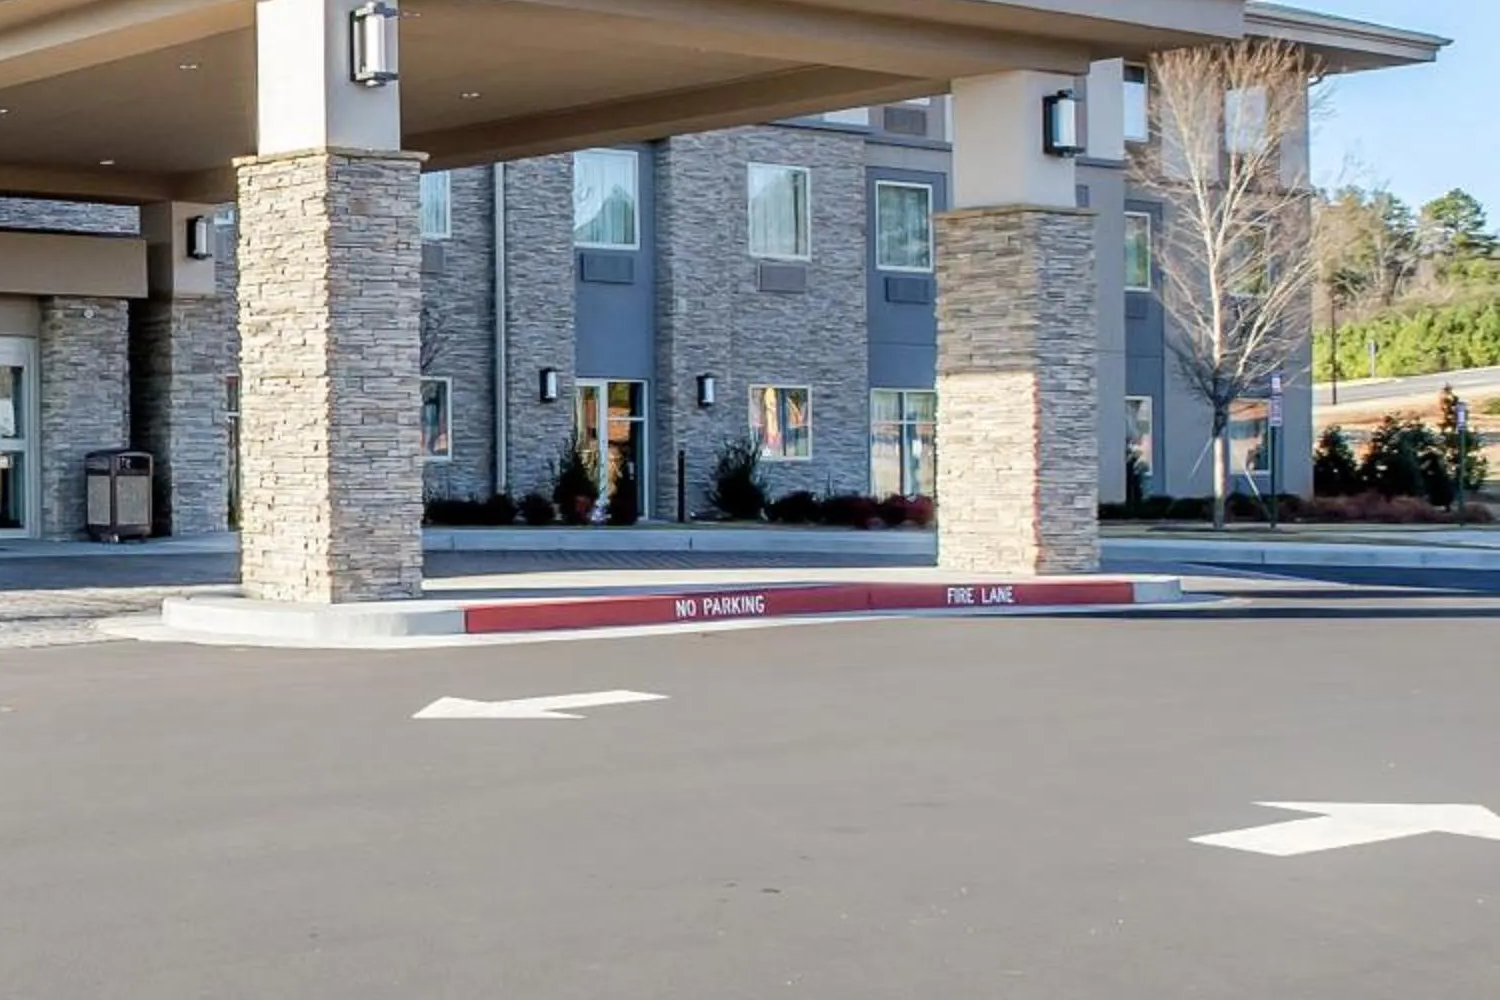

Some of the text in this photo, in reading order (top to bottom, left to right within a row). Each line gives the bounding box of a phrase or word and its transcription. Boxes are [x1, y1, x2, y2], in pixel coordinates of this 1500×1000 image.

[947, 585, 1015, 605] FIRE LANE
[675, 595, 765, 617] NO PARKING
